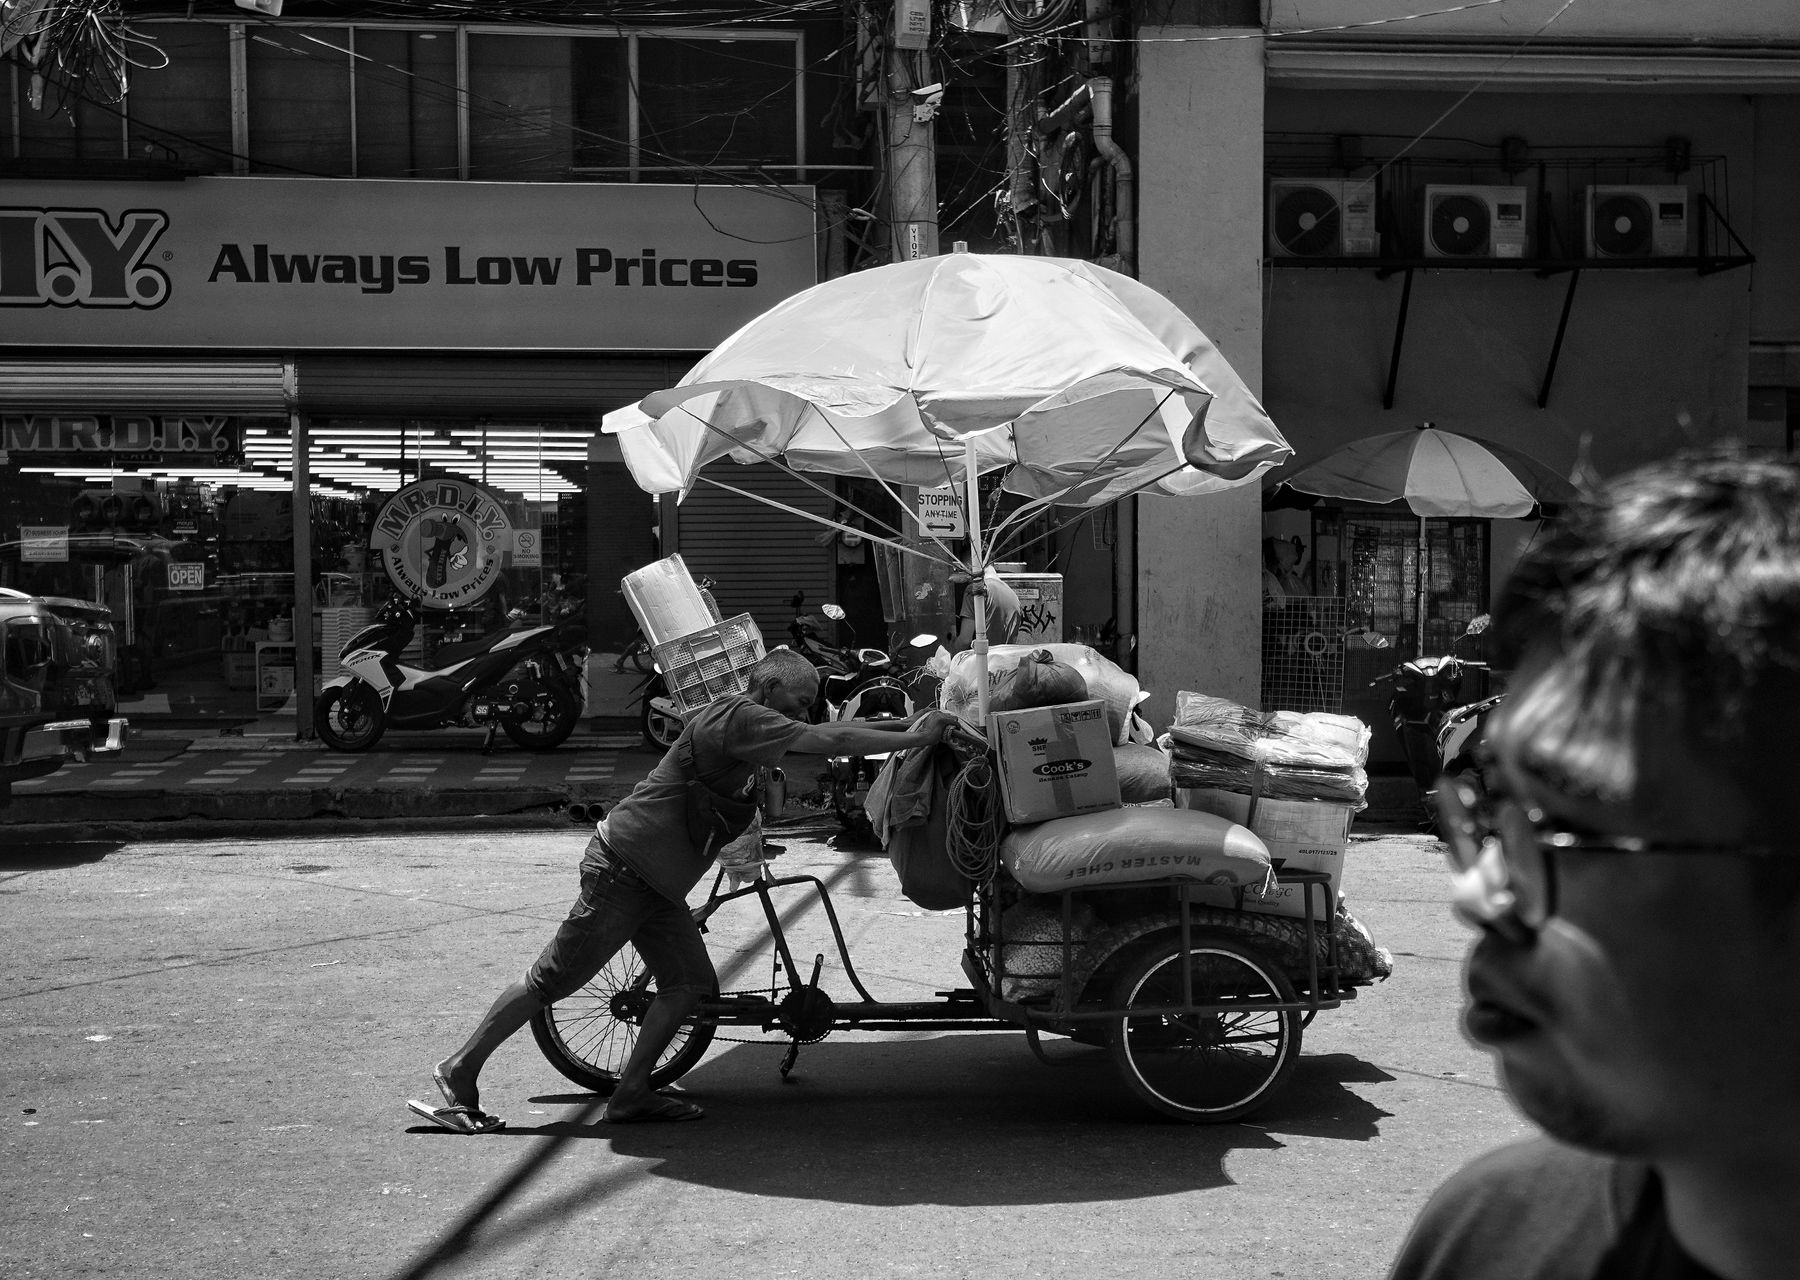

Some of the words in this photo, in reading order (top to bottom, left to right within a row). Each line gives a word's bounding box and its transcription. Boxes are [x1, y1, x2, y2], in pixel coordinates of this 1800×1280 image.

[207, 243, 430, 294] Always
[444, 246, 562, 286] Low
[575, 247, 758, 288] Prices
[918, 494, 963, 506] STOPPING
[924, 509, 958, 519] ANYTIME
[170, 570, 202, 584] OPEN
[392, 556, 428, 598] Always
[431, 588, 460, 600] Low
[461, 558, 494, 595] Prices
[1040, 761, 1084, 775] Cook's
[1121, 855, 1201, 869] MASTER
[1063, 862, 1114, 881] CHEF
